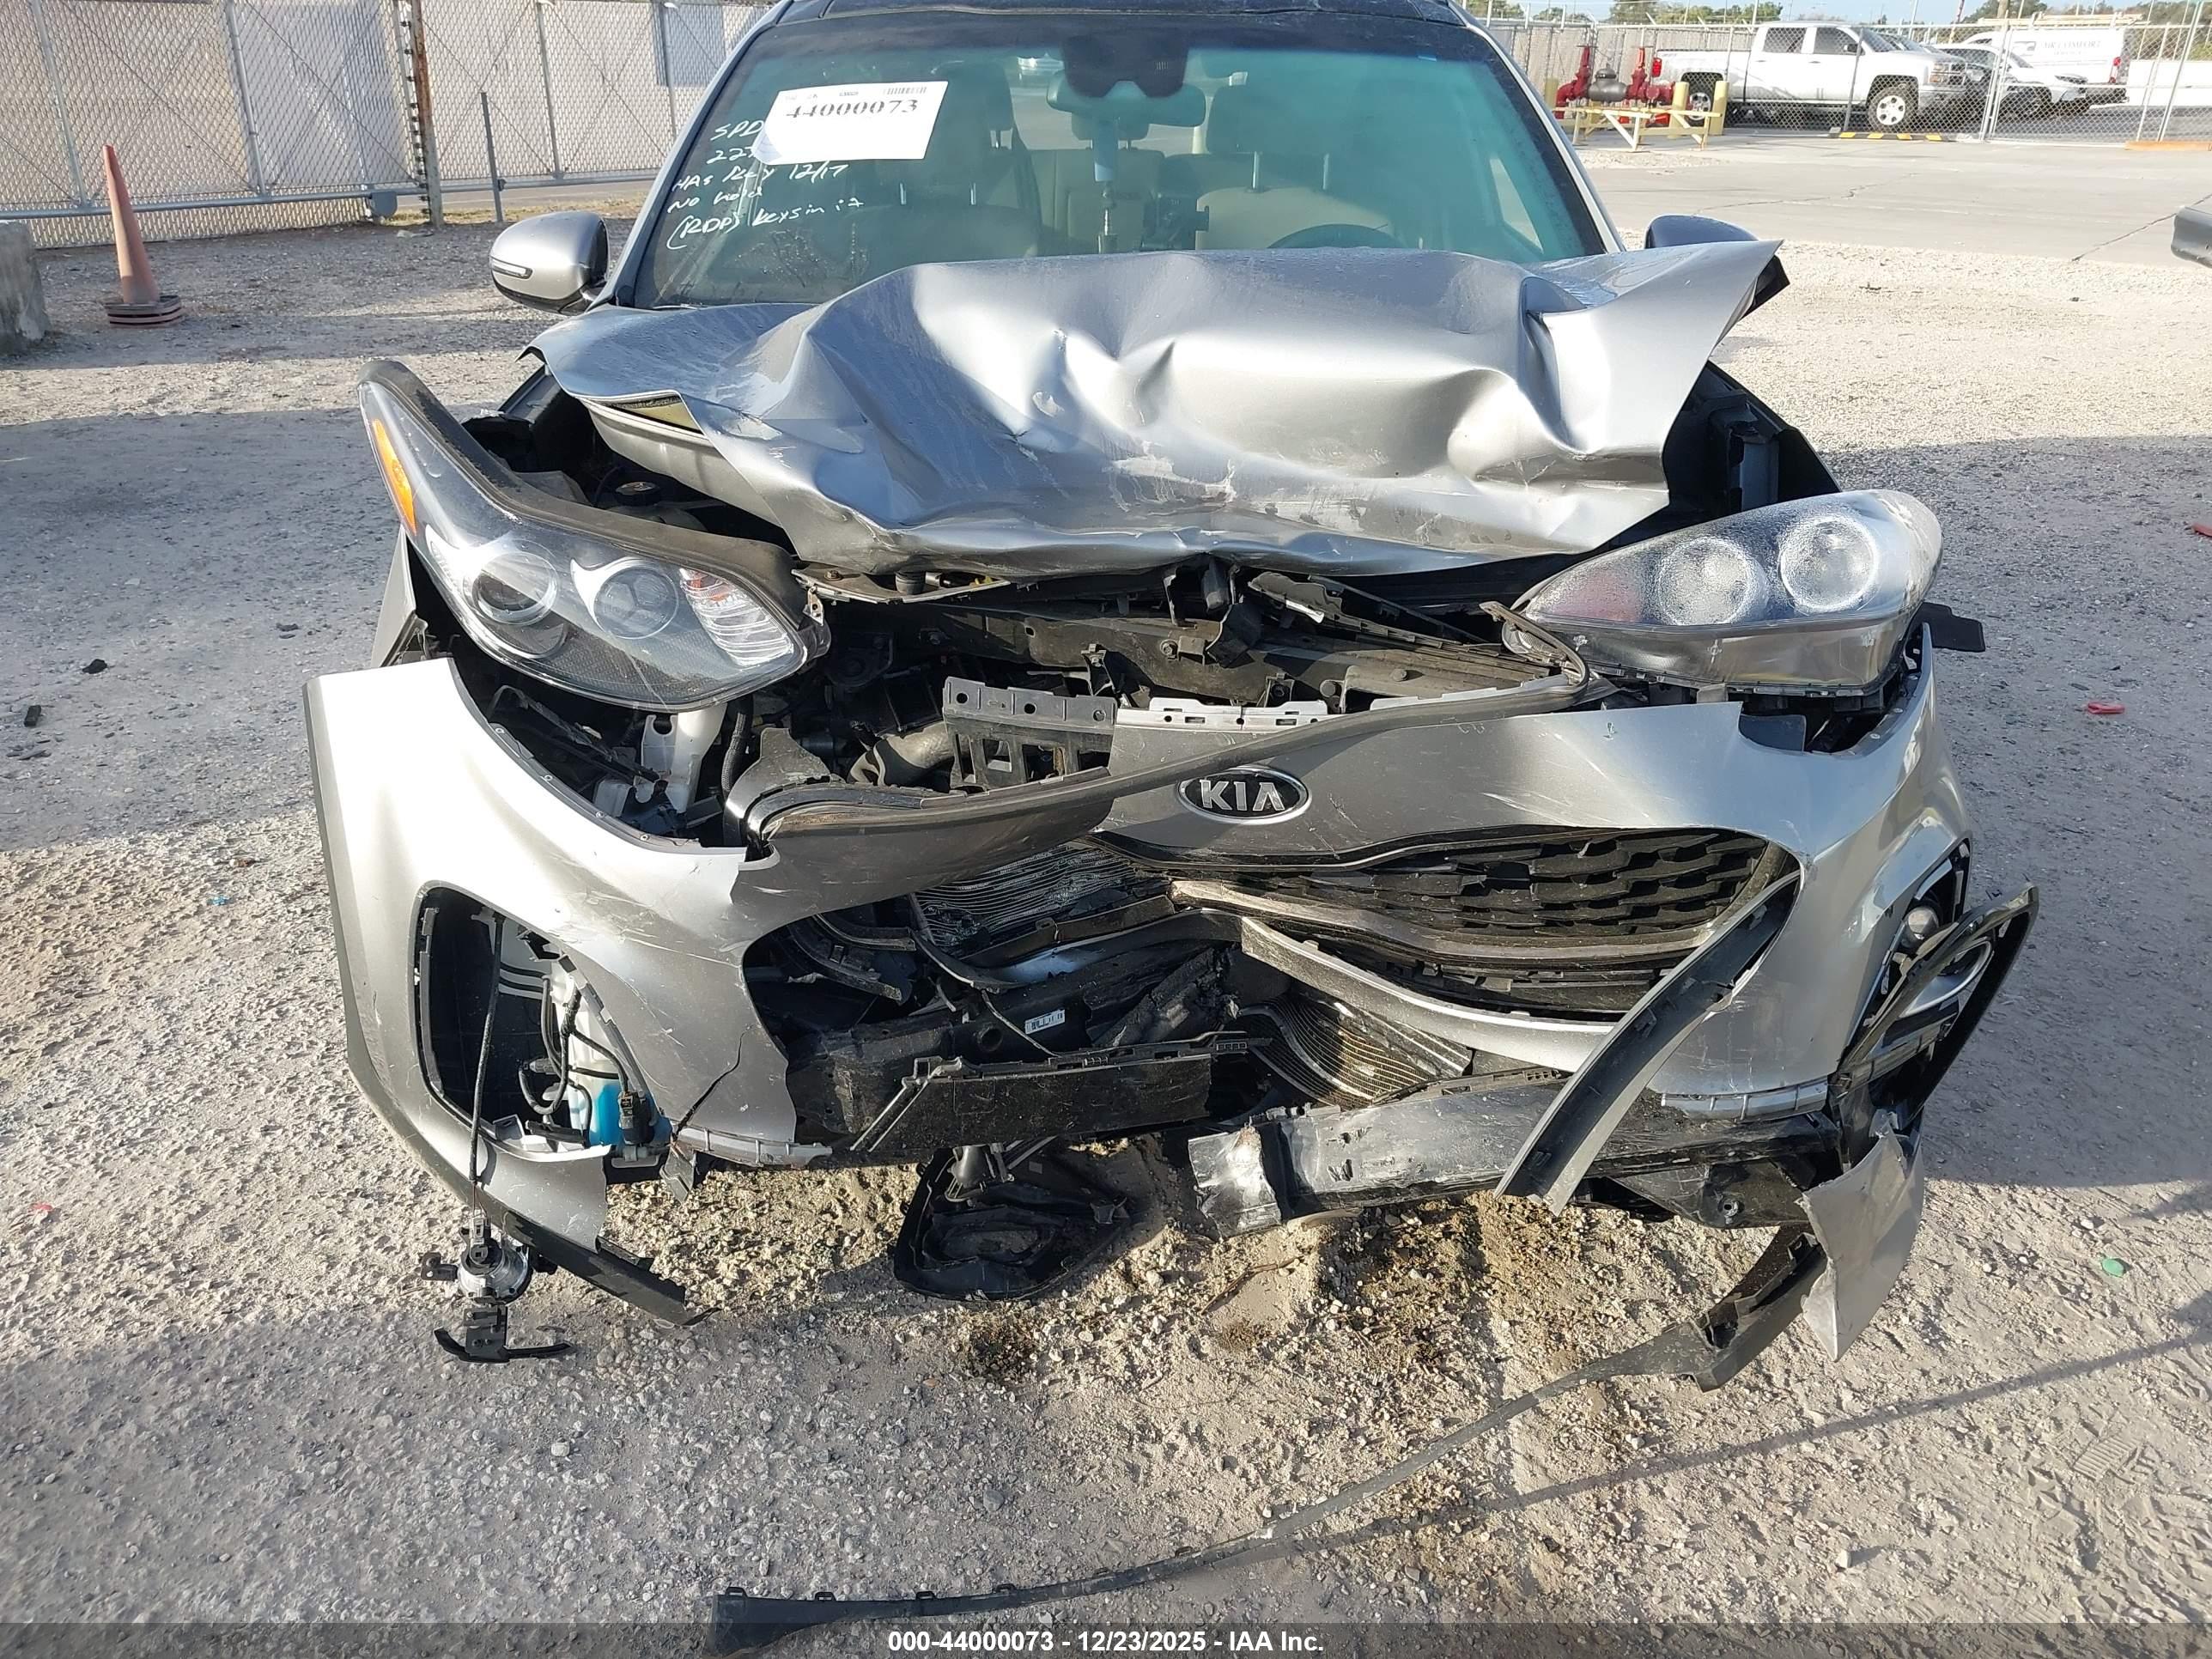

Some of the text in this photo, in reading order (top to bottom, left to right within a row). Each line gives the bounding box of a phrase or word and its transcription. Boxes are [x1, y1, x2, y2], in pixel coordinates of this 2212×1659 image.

[786, 100, 918, 118] 44000073
[789, 161, 848, 183] 12/17
[1200, 780, 1285, 811] KIA
